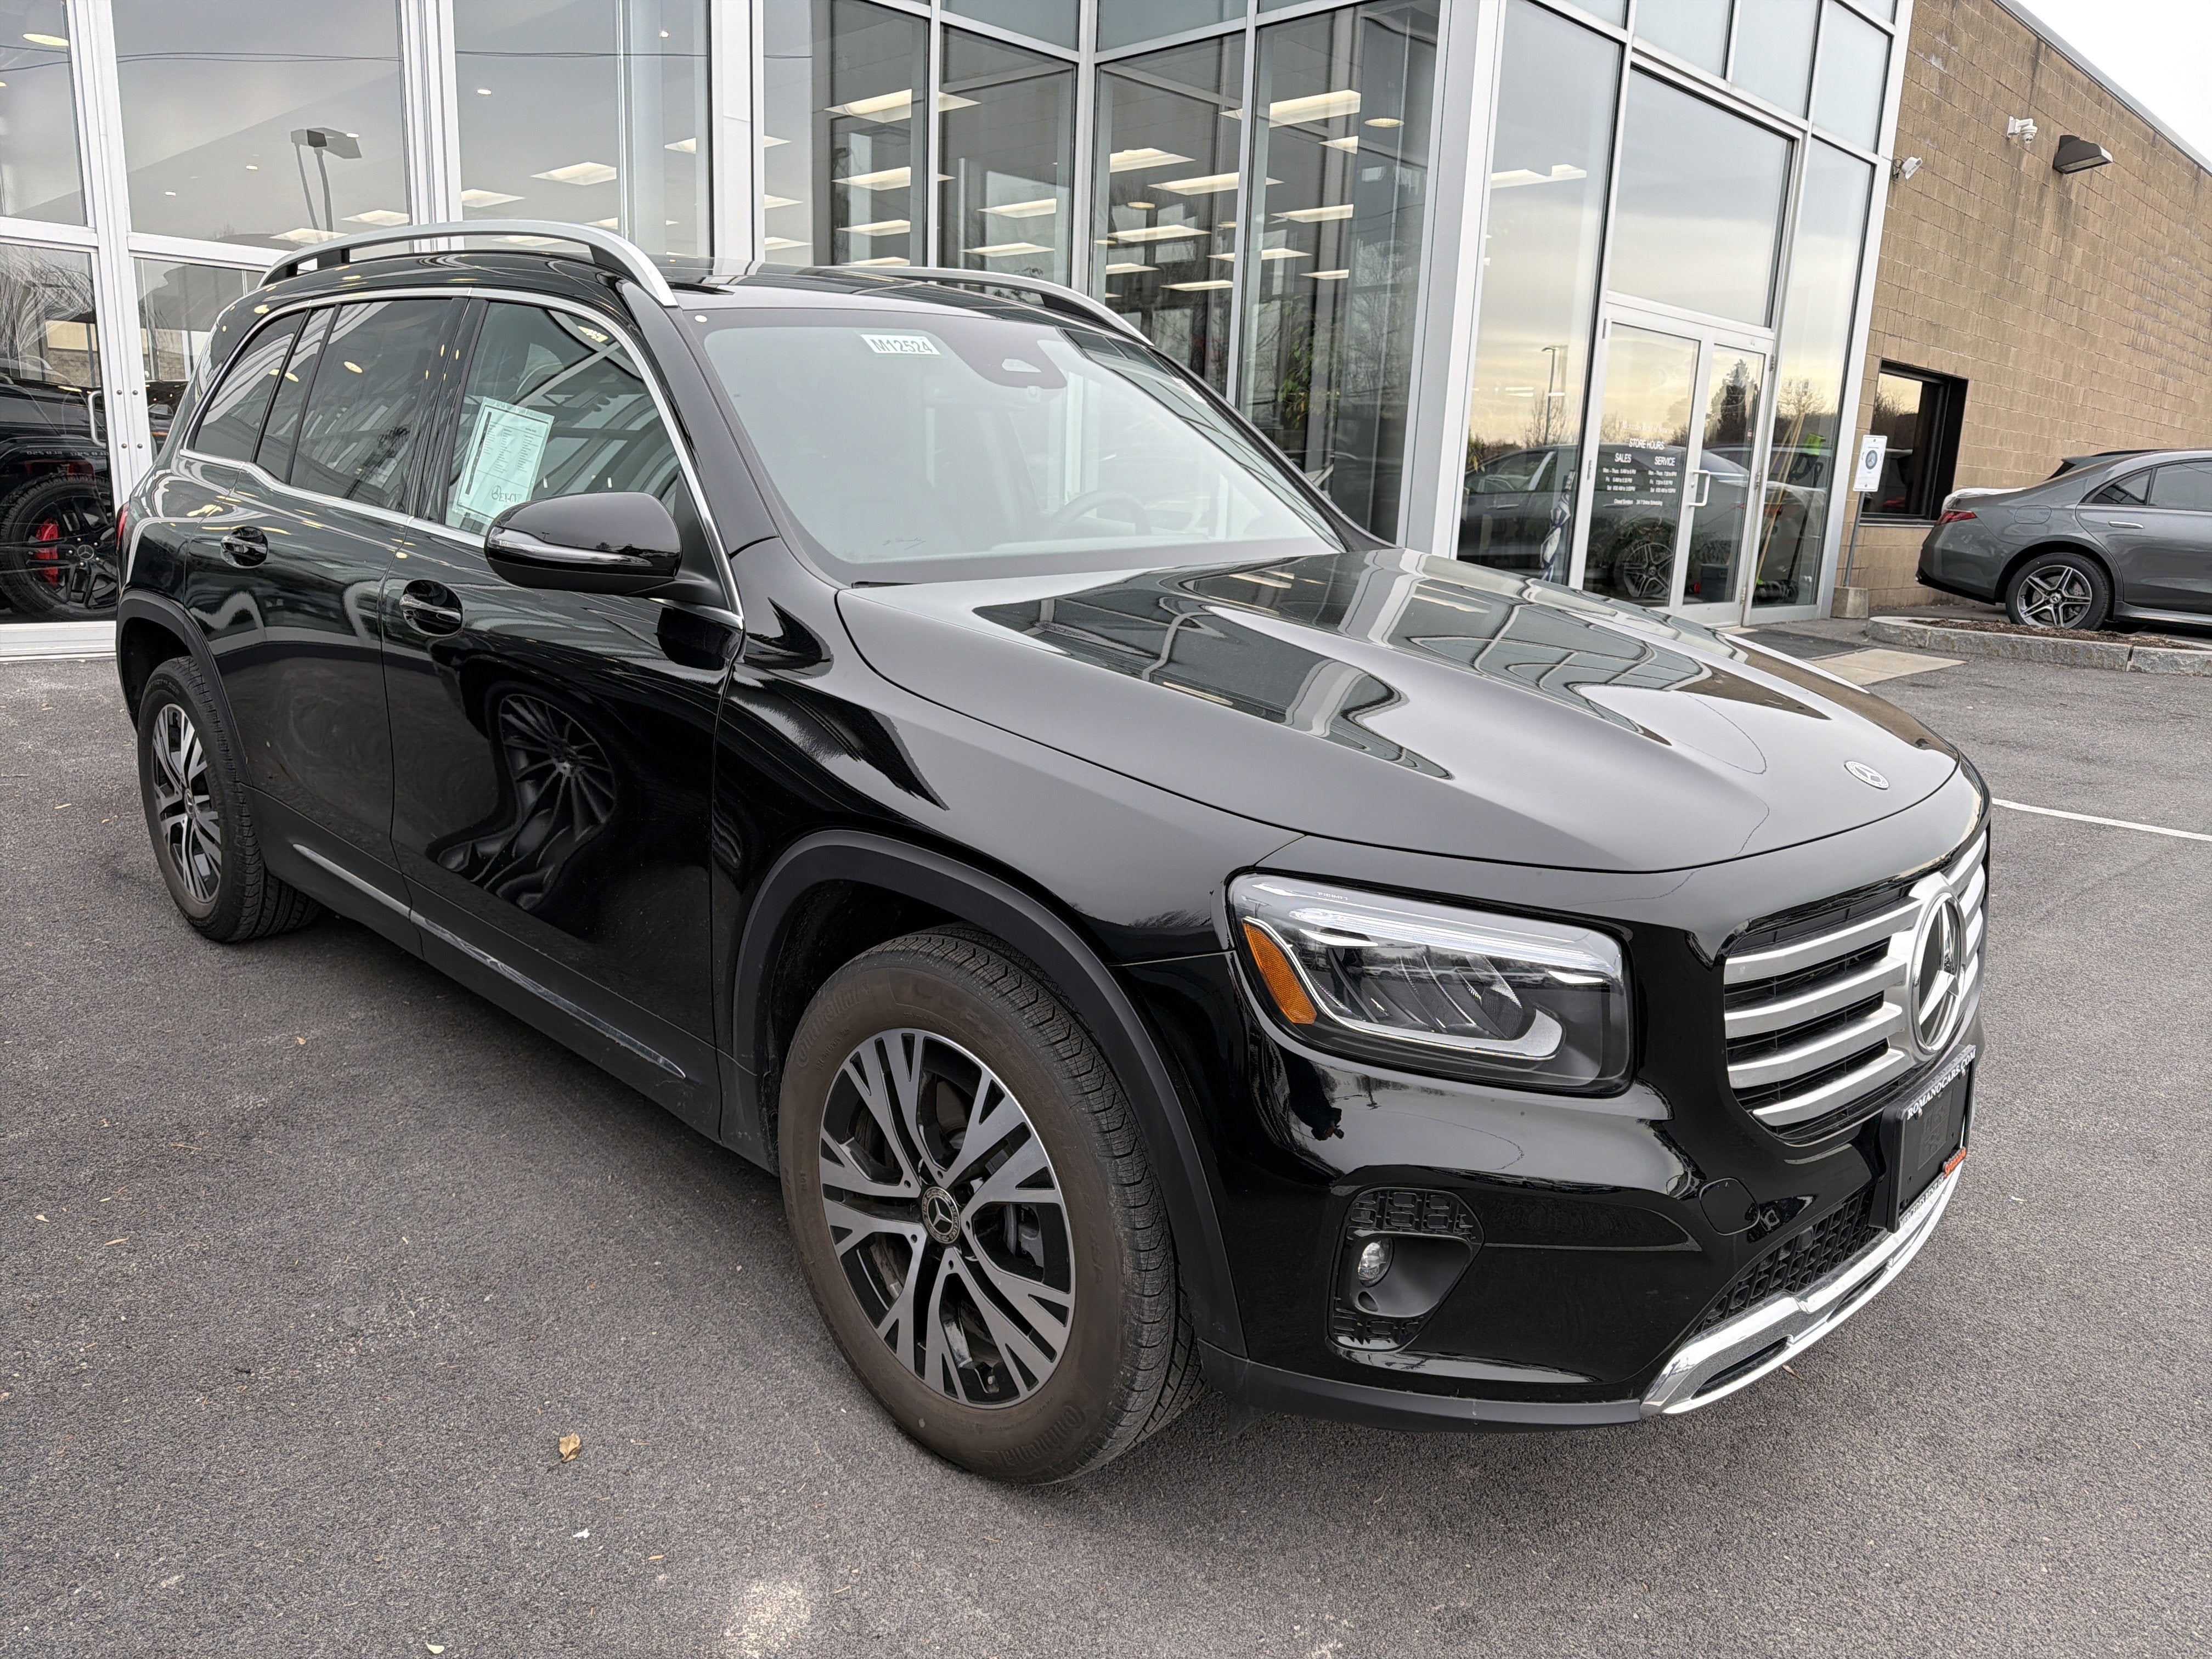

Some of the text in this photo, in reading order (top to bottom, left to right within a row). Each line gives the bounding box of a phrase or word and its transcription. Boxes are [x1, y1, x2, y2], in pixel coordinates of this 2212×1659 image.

[870, 338, 933, 353] M12524
[1629, 438, 1665, 450] STORE HOURS
[1615, 453, 1632, 463] SALES
[1654, 456, 1675, 466] SERVICE
[1906, 1047, 1976, 1120] ROMANOCARS.COM
